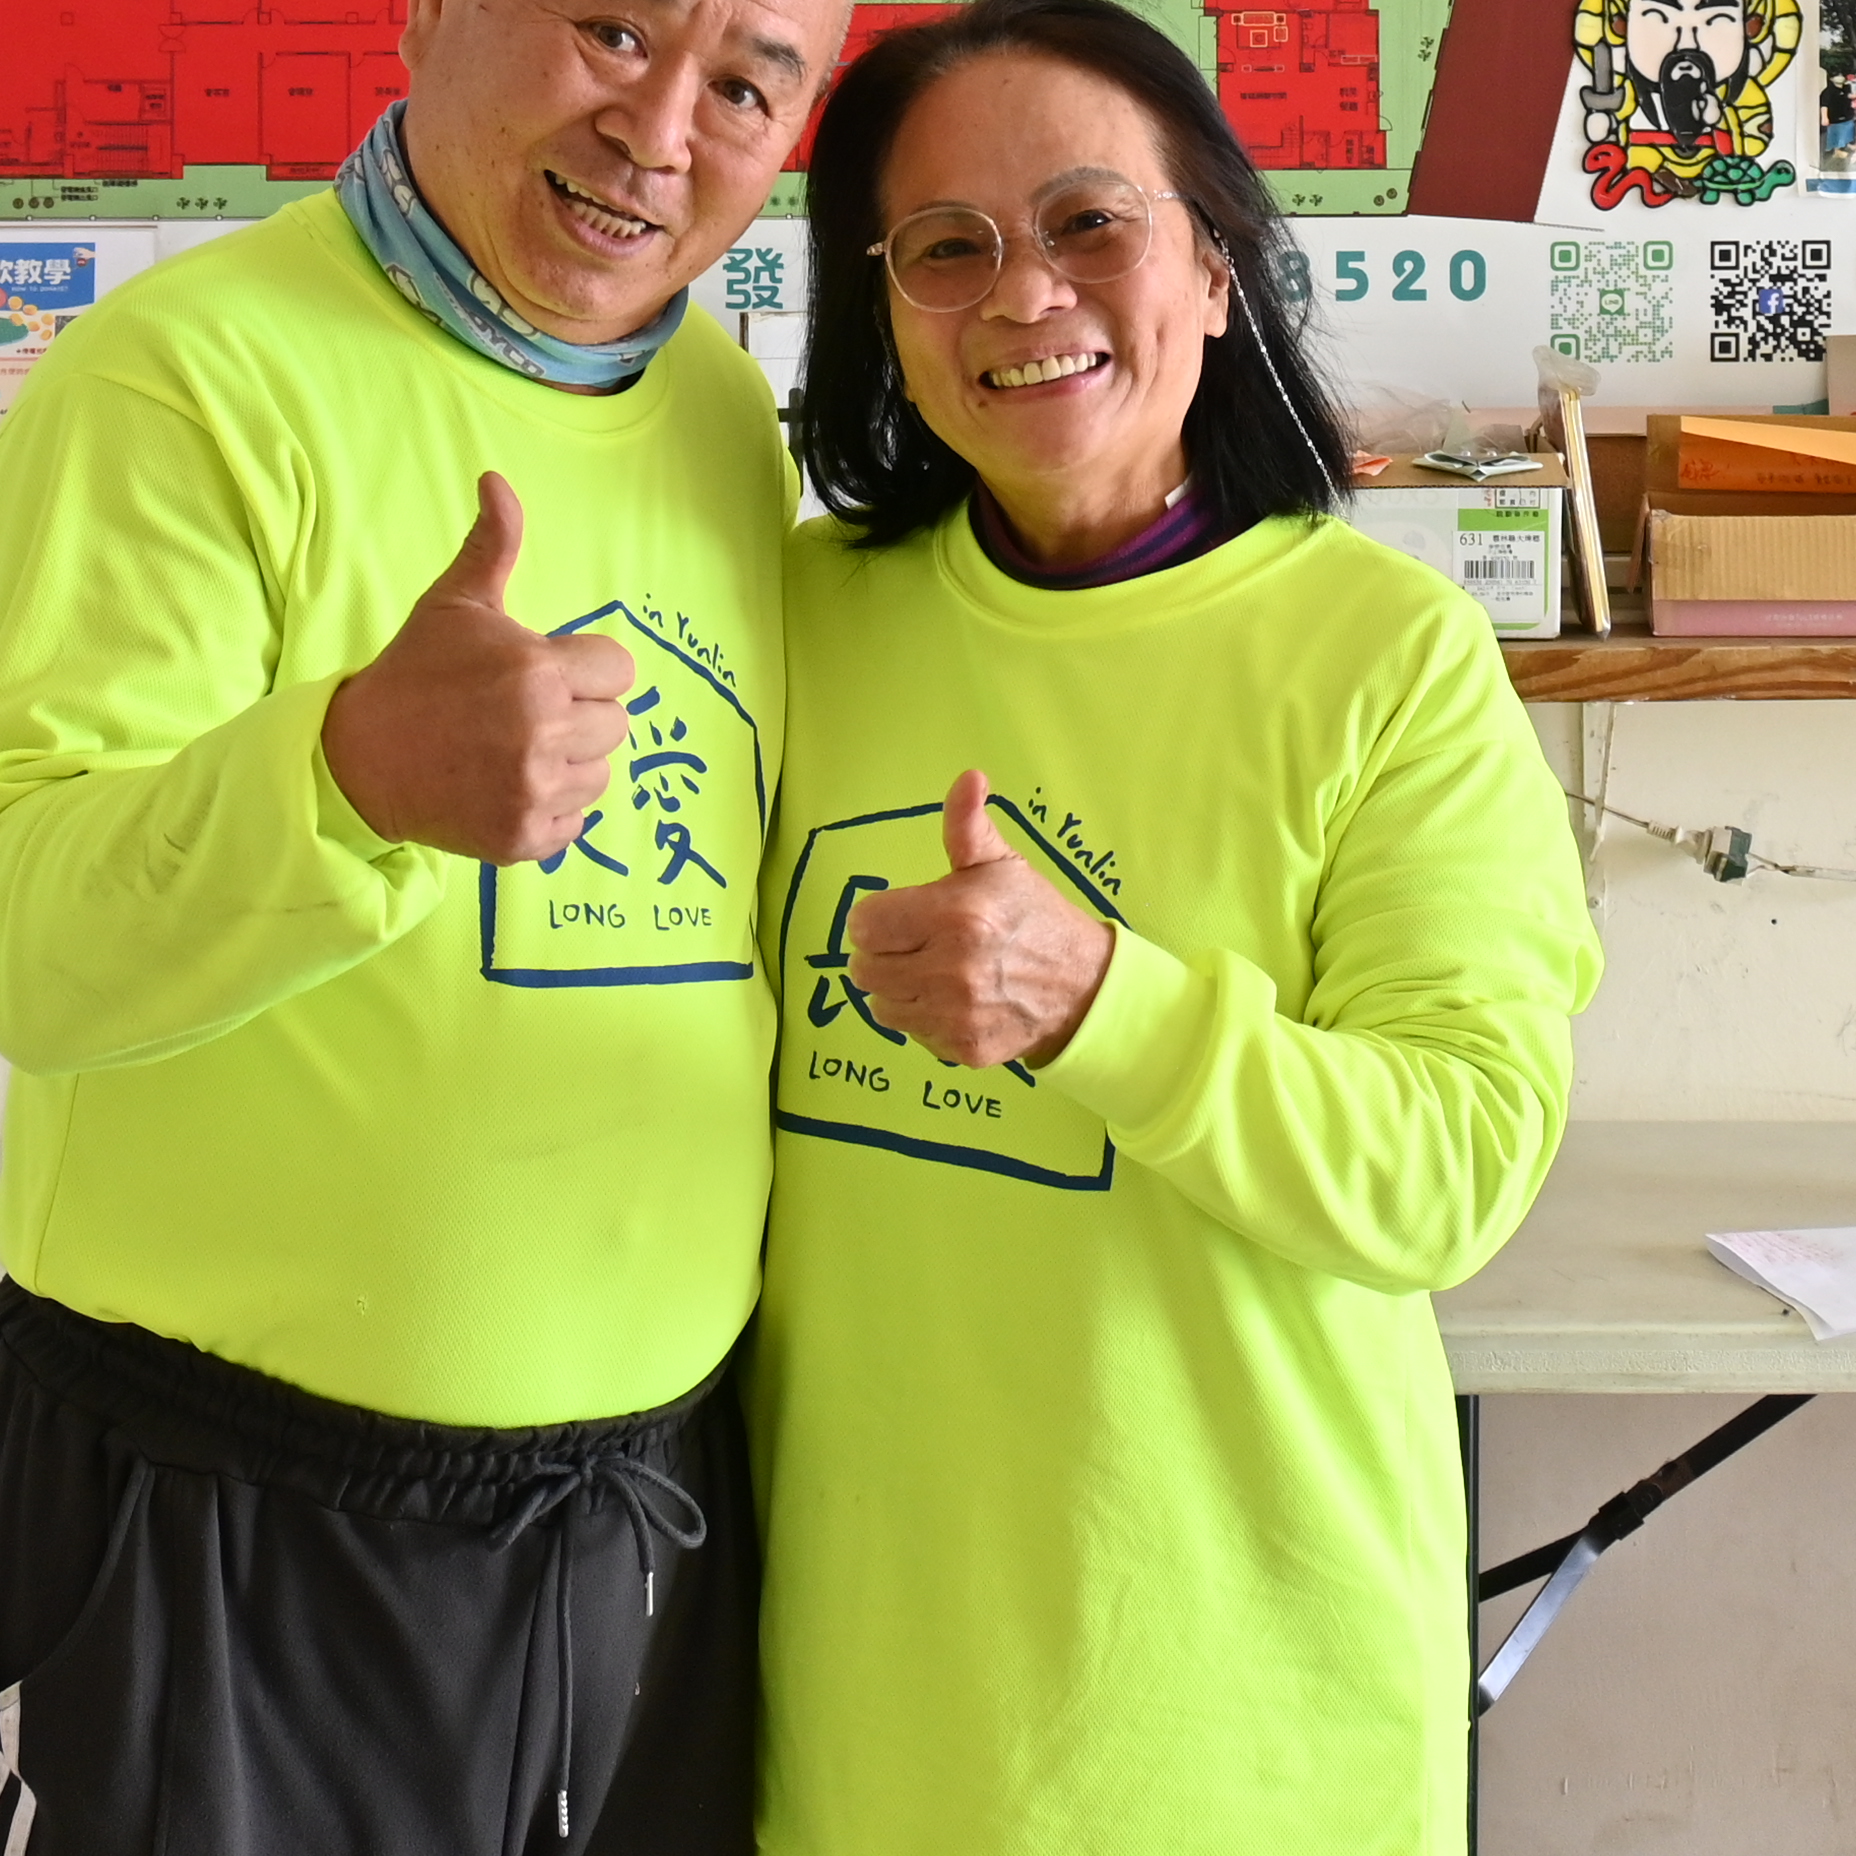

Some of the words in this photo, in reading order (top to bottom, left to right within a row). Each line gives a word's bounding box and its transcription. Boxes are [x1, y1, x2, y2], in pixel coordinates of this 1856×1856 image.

[723, 247, 784, 309] 發
[1460, 532, 1483, 546] 631
[643, 593, 663, 626] in
[676, 611, 737, 687] Yunlin
[1027, 788, 1046, 825] in
[1056, 814, 1122, 896] Yunlin
[549, 900, 626, 929] LONG
[653, 903, 712, 930] LOVE
[809, 1050, 891, 1093] LONG
[923, 1082, 1002, 1119] LOVE
